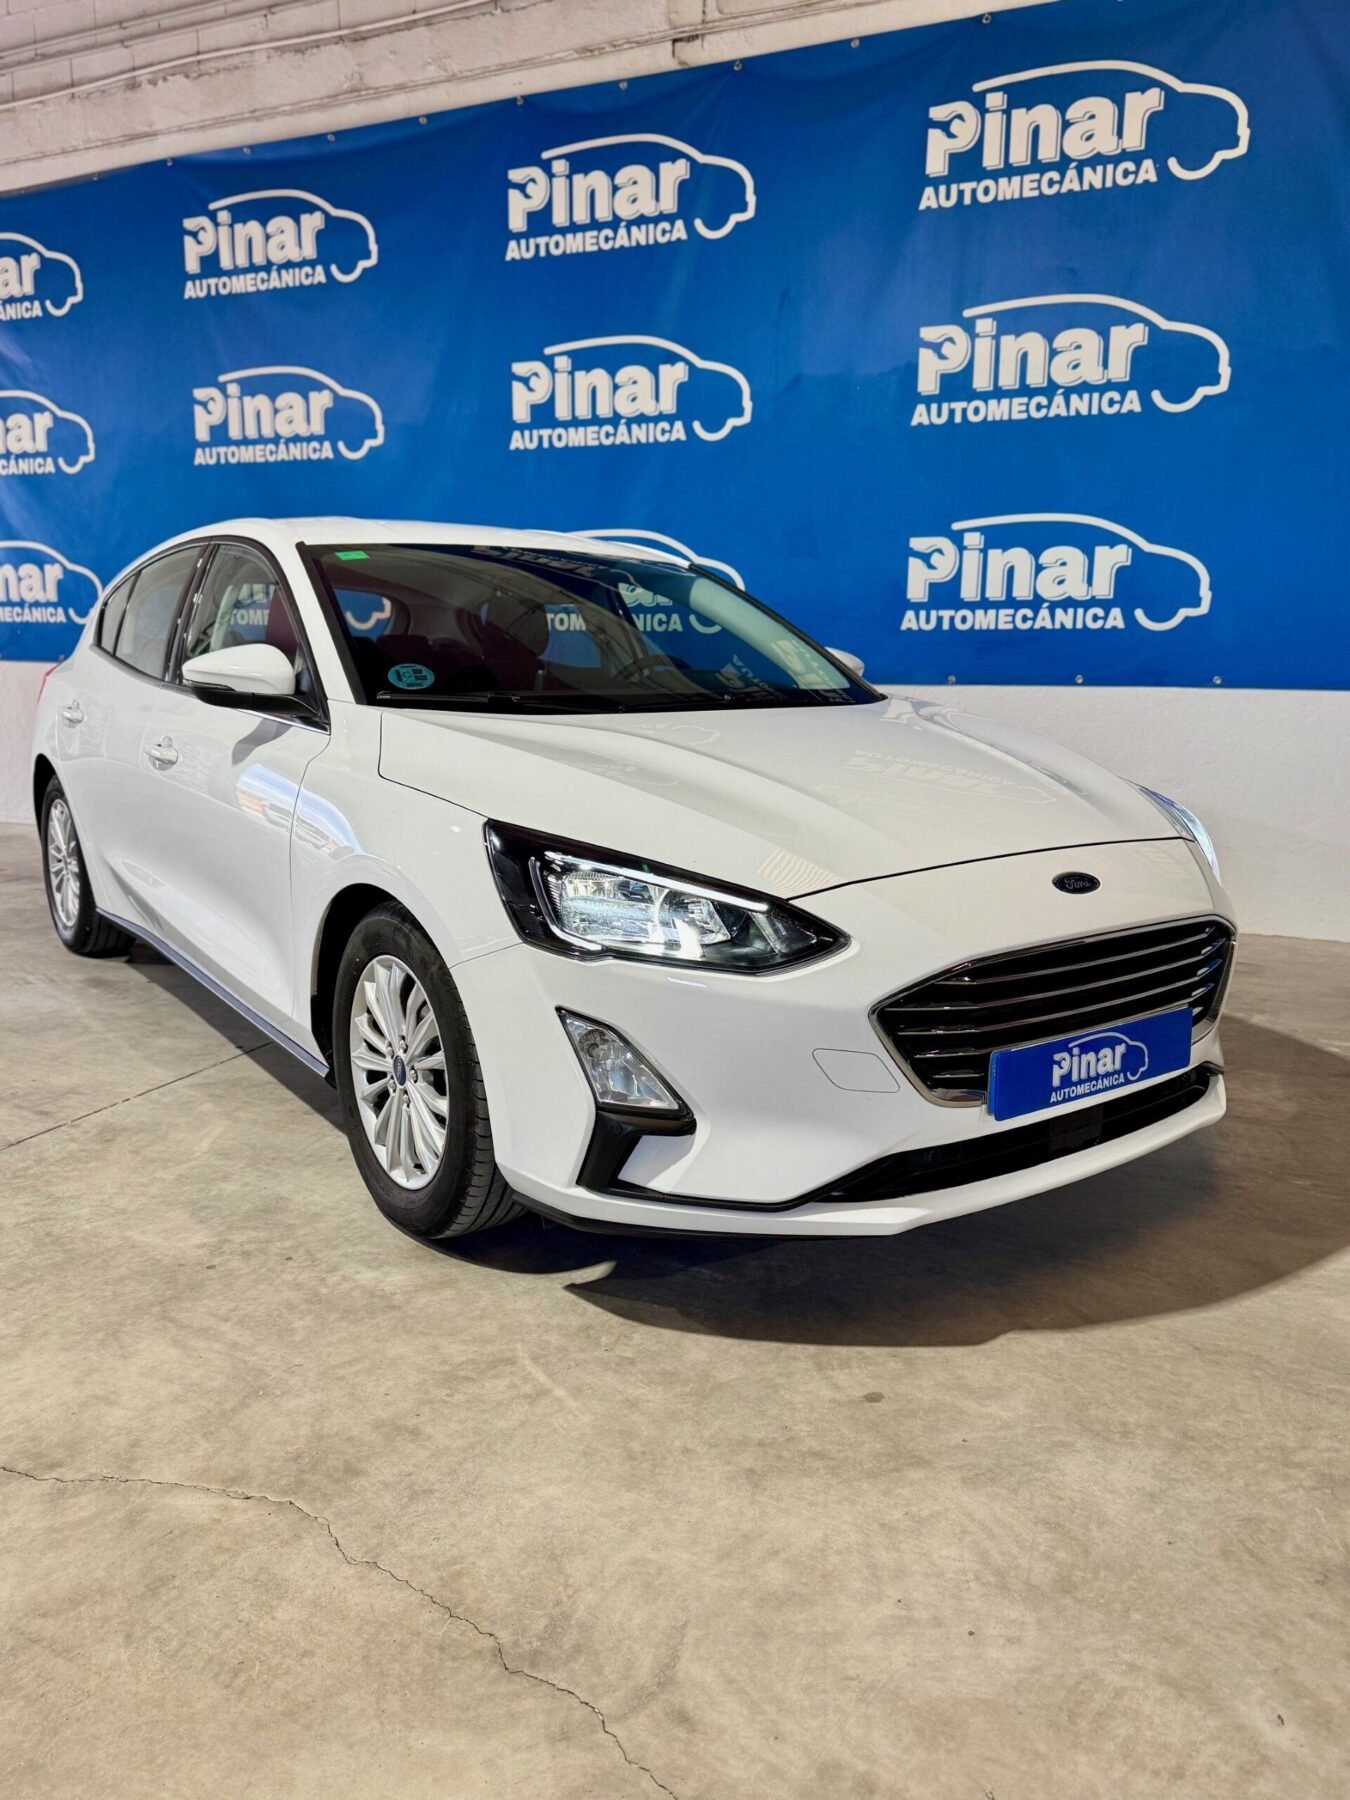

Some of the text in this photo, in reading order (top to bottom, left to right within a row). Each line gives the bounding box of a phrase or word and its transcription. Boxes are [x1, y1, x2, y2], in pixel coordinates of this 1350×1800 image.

[925, 87, 1165, 178] Pinar
[507, 158, 691, 233] Pinar
[918, 158, 1158, 211] AUTOMECÁNICA
[182, 209, 325, 275] Pinar
[505, 220, 688, 261] AUTOMECÁNICA
[183, 264, 327, 300] AUTOMECÁNICA
[917, 317, 1149, 395] Pinar
[192, 382, 335, 442] Pinar
[511, 355, 689, 425] Pinar
[910, 388, 1142, 426] AUTOMECÁNICA
[194, 438, 334, 466] AUTOMECÁNICA
[509, 417, 687, 450] AUTOMECÁNICA
[906, 531, 1132, 603] Pinar
[900, 602, 1125, 631] AUTOMECÁNICA
[1050, 1072, 1125, 1103] AUTOMECÁNICA
[1052, 1042, 1126, 1088] Pinar
